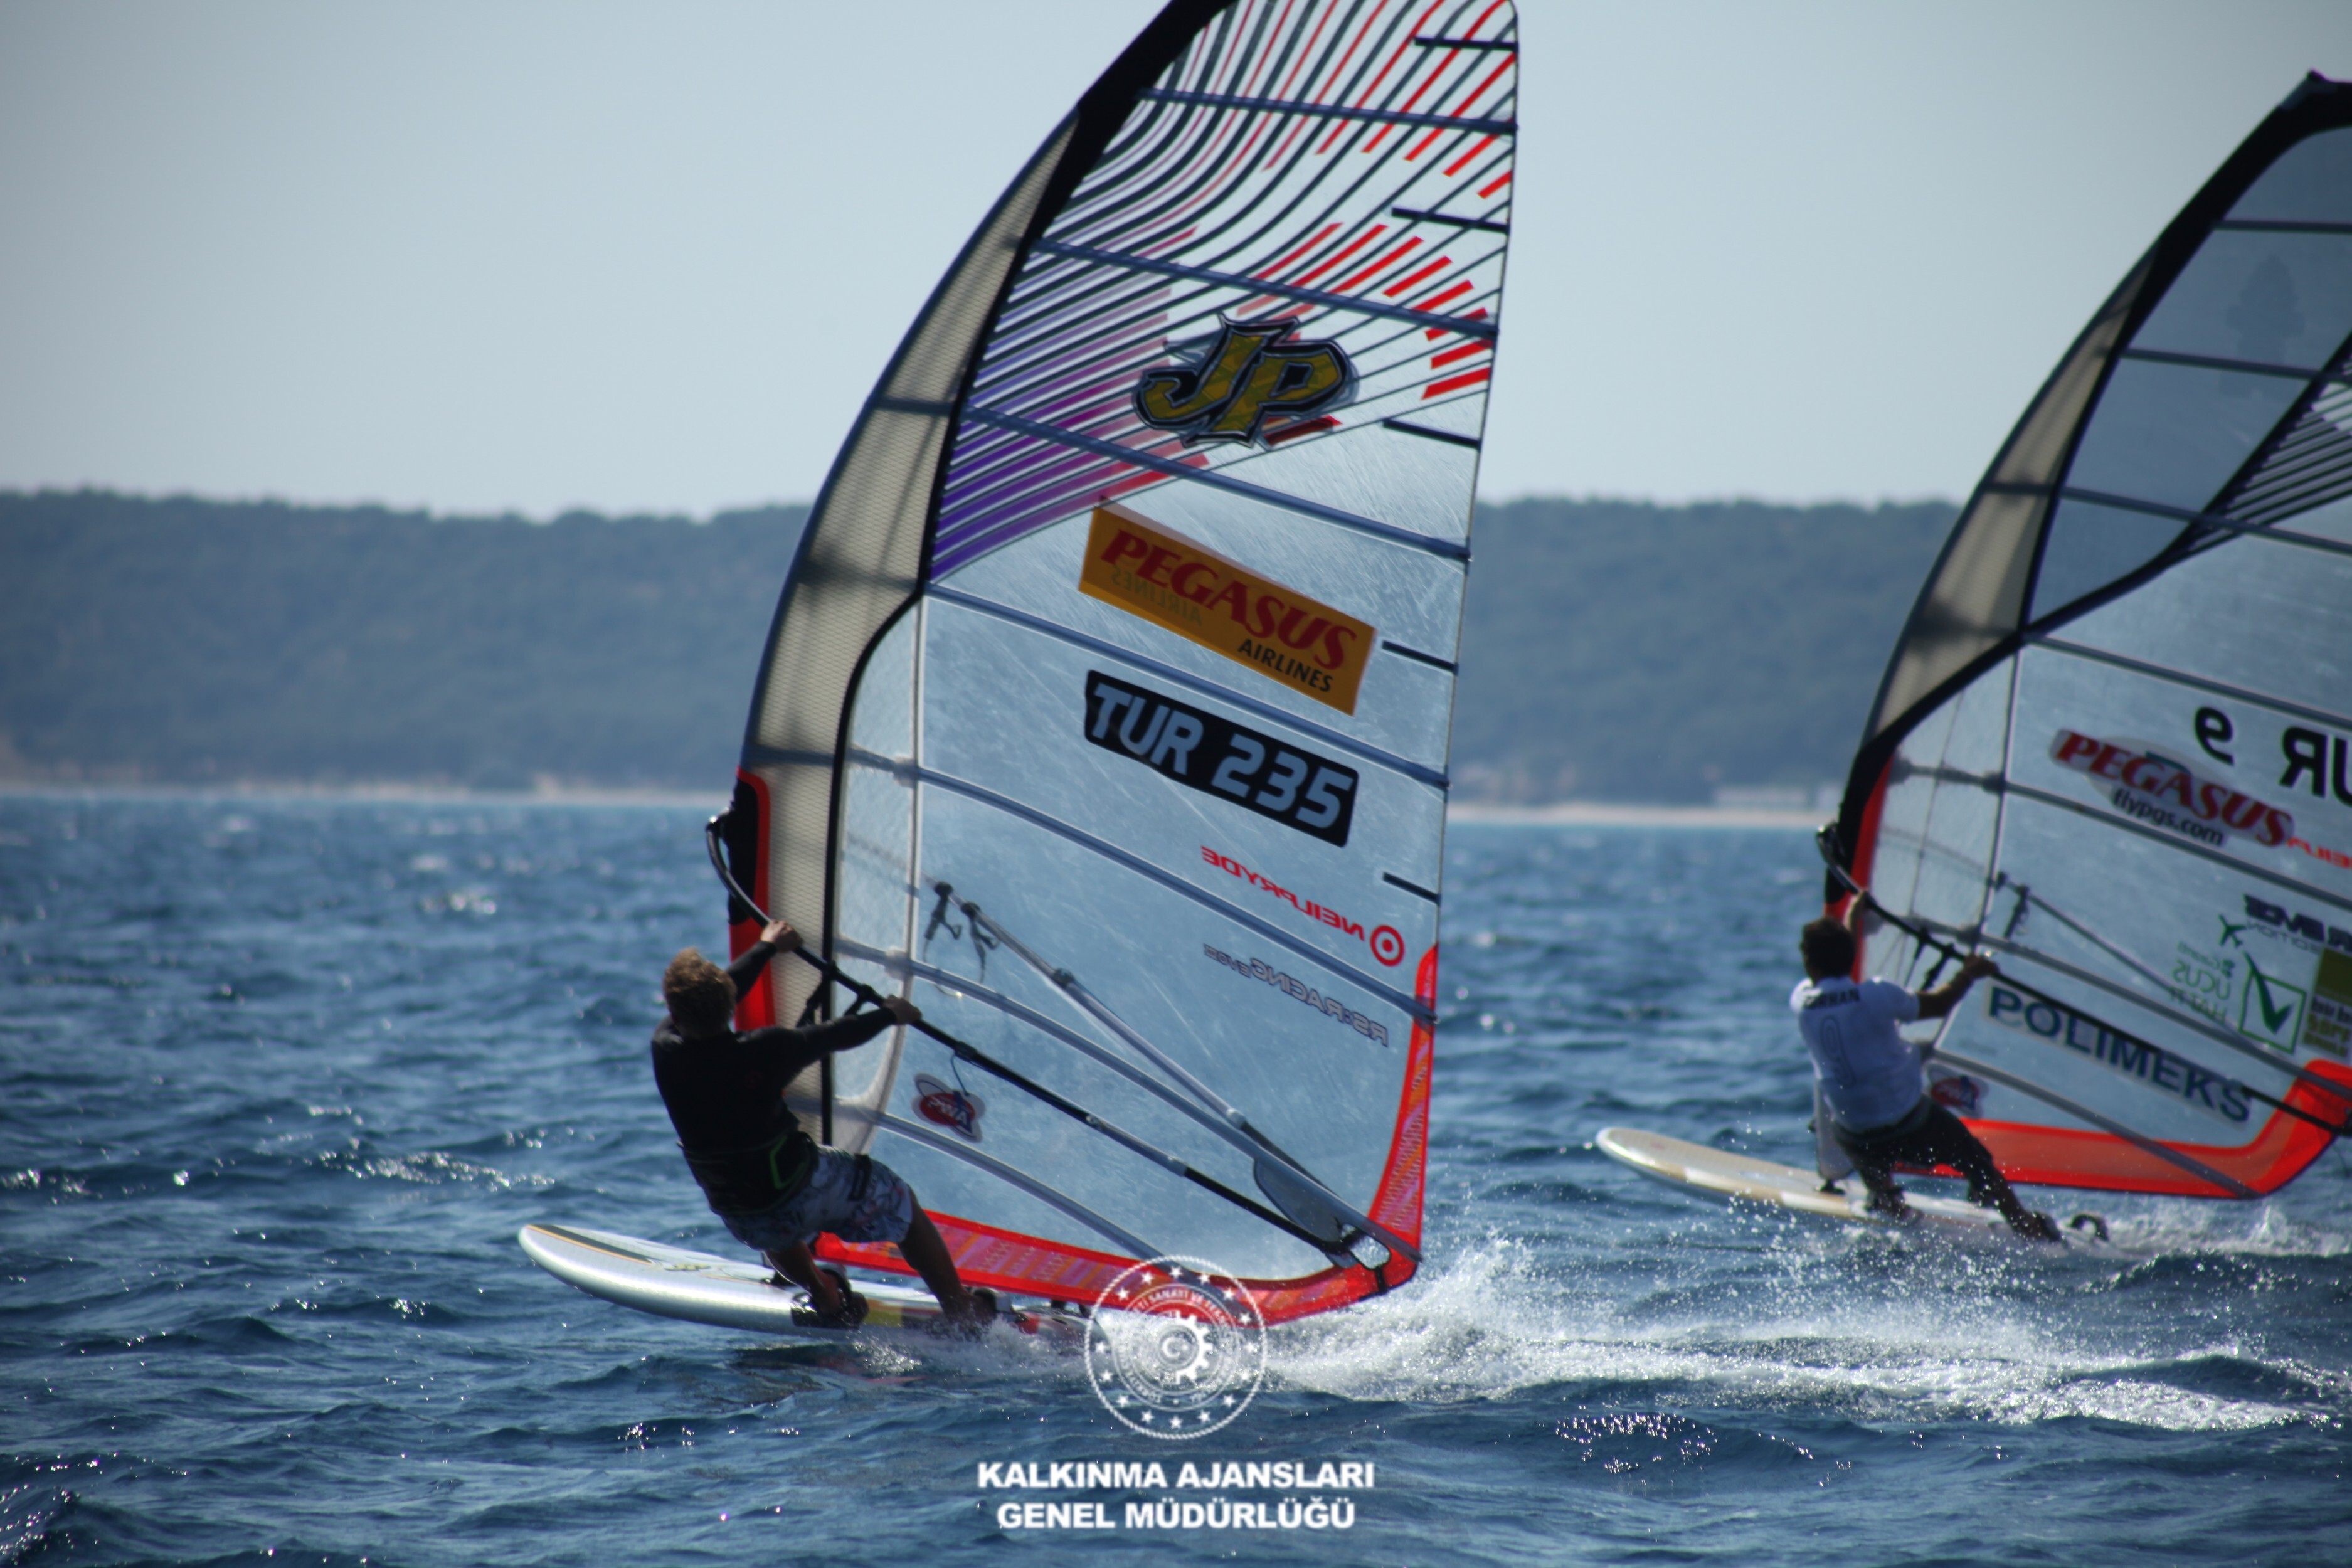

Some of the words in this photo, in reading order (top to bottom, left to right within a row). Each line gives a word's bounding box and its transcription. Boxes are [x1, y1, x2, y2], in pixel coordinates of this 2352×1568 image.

[1131, 312, 1352, 447] JP
[1101, 529, 1357, 670] PEGASUS
[1237, 638, 1333, 692] AIRLINES
[1091, 682, 1204, 776] TUR
[1211, 733, 1353, 829] 235
[2055, 732, 2293, 847] PEGASUS
[2112, 787, 2225, 847] flypgs.com
[1988, 985, 2252, 1123] POLIMEKS
